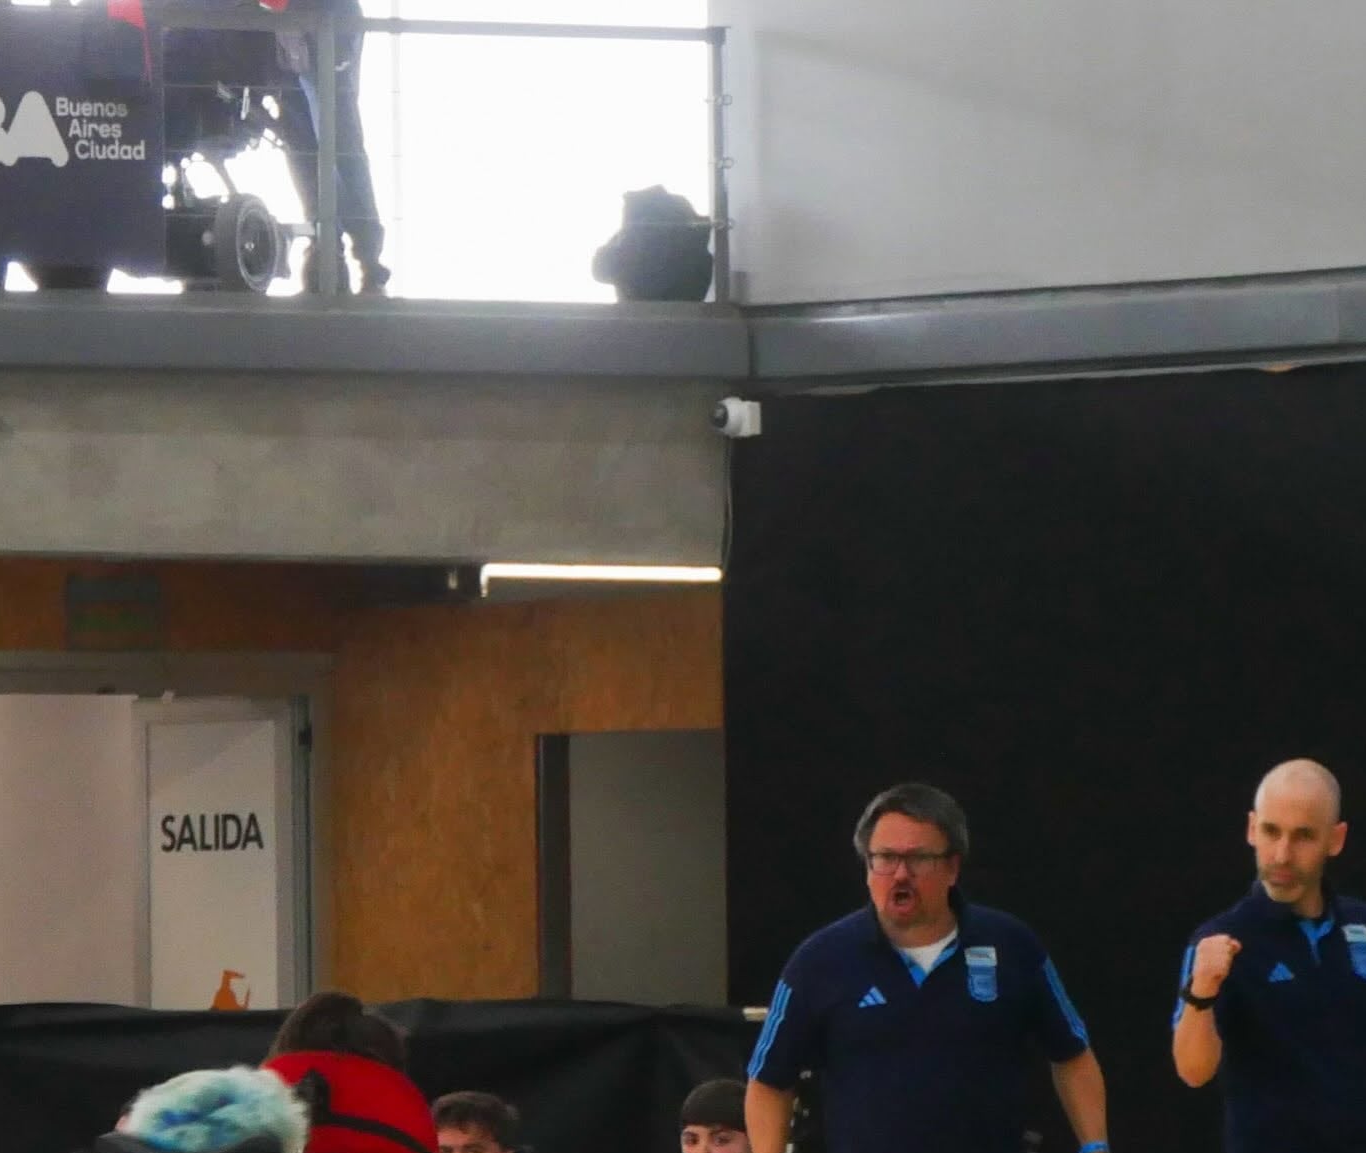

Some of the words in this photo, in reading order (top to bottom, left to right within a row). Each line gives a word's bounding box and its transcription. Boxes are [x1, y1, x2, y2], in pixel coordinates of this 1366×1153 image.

[55, 97, 129, 118] Buenos
[68, 121, 123, 138] Aires
[74, 140, 146, 160] Ciudad
[160, 812, 265, 853] SALIDA
